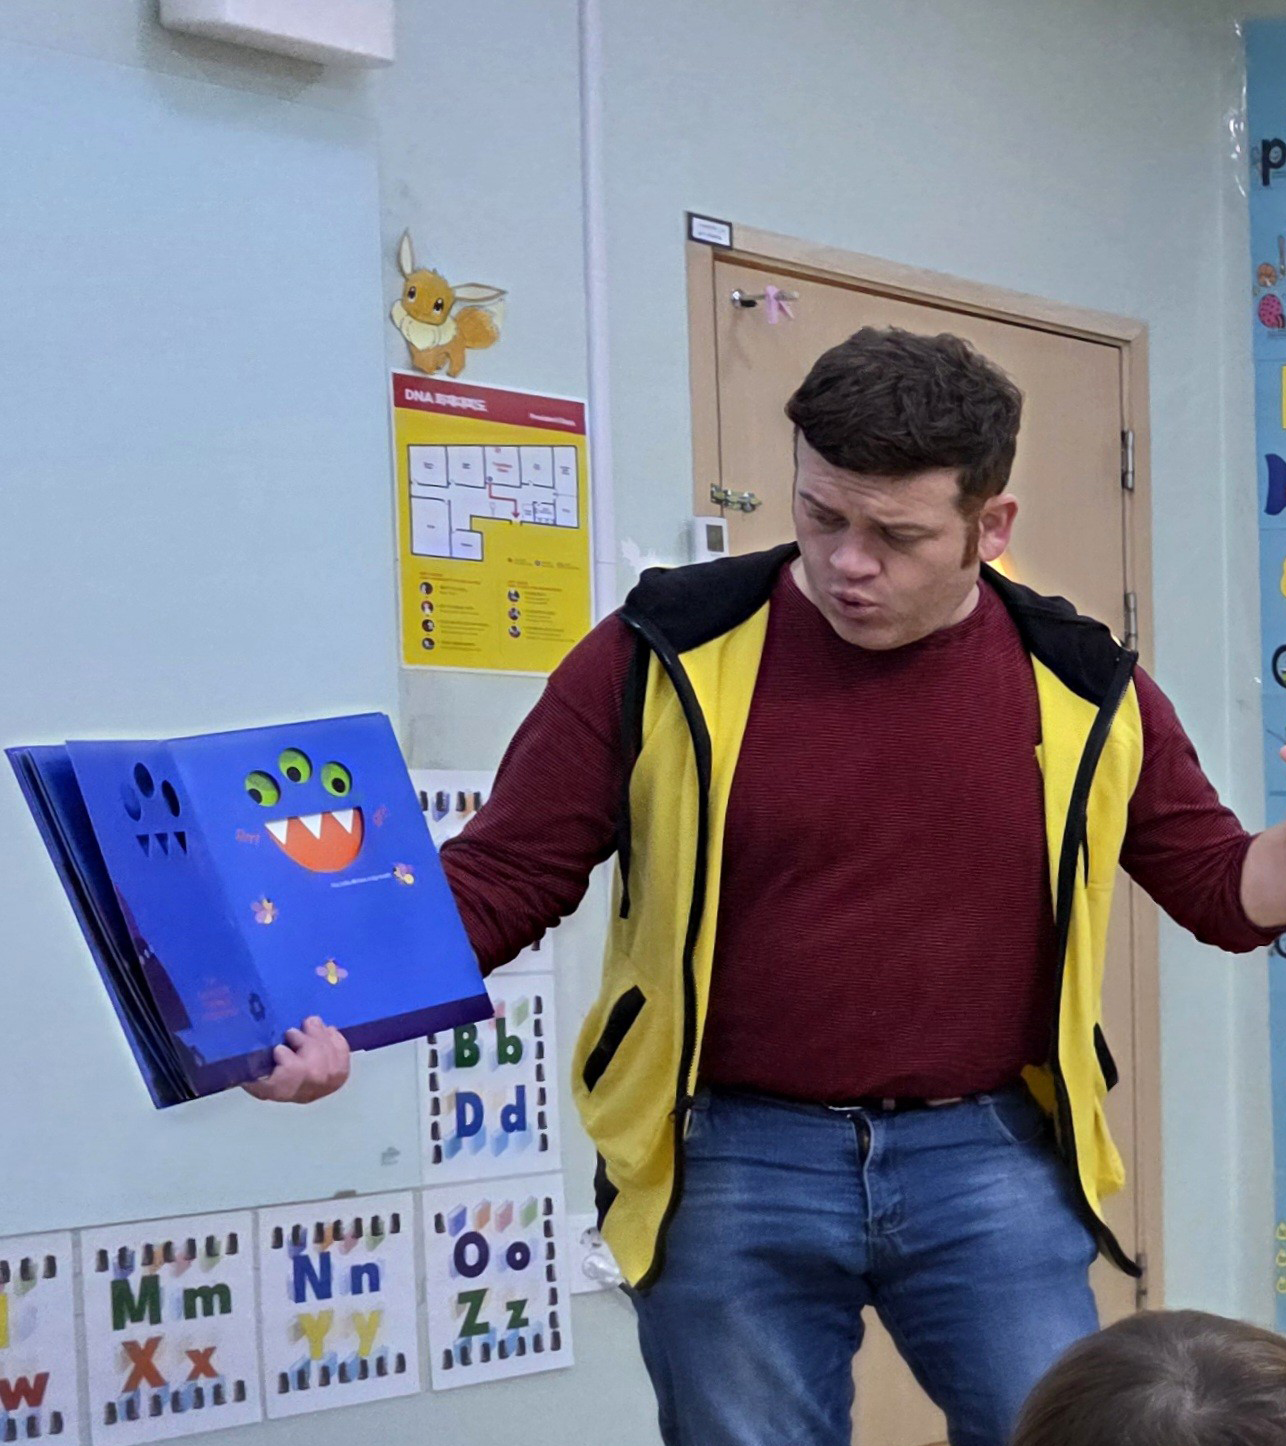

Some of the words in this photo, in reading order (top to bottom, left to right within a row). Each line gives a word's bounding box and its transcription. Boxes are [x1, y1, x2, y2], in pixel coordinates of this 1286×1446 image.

[405, 389, 433, 403] DNA
[454, 1024, 480, 1068] B
[496, 1017, 523, 1065] b
[456, 1092, 483, 1137] D
[500, 1085, 526, 1132] d
[292, 1252, 331, 1303] N
[350, 1259, 380, 1296] n
[455, 1232, 489, 1276] O
[505, 1241, 531, 1270] o
[110, 1273, 163, 1331] M
[184, 1278, 232, 1320] m
[458, 1289, 491, 1338] Z
[505, 1298, 529, 1328] z
[298, 1309, 334, 1360] Y
[352, 1312, 380, 1359] y
[122, 1336, 165, 1392] X
[187, 1346, 218, 1379] x
[0, 1372, 49, 1411] w
